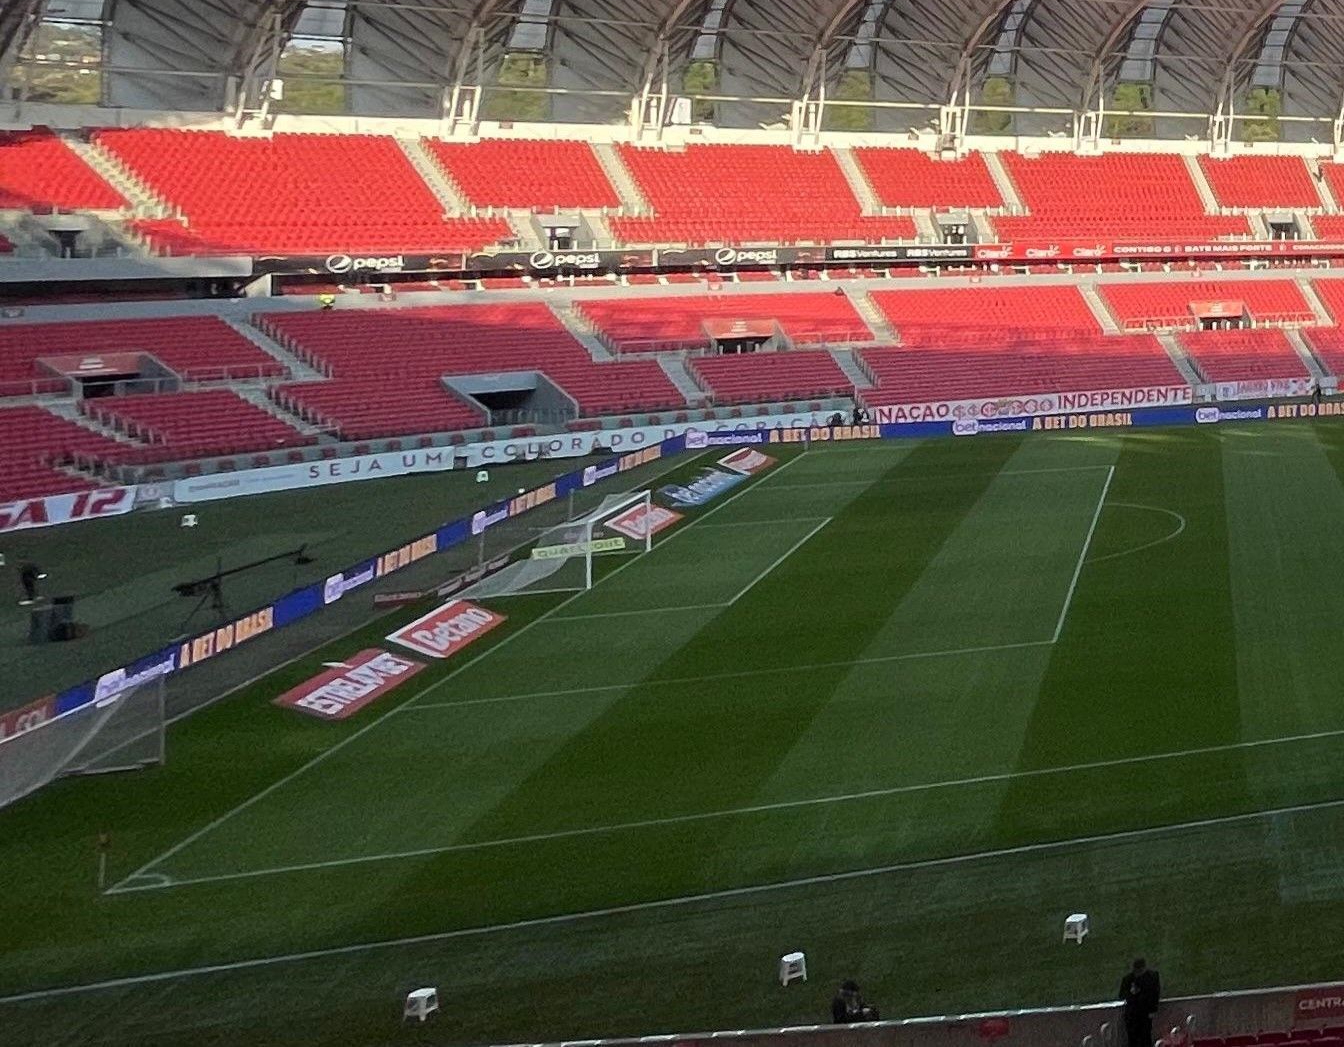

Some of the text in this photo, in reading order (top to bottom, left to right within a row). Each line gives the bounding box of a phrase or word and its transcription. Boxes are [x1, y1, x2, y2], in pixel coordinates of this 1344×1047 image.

[353, 254, 404, 270] pepsi
[554, 251, 600, 266] pepsi
[736, 249, 778, 263] pepsi
[1057, 387, 1191, 410] INDEPENDENTE
[309, 459, 383, 479] SEJA
[403, 452, 442, 469] UM
[411, 608, 494, 652] Betano
